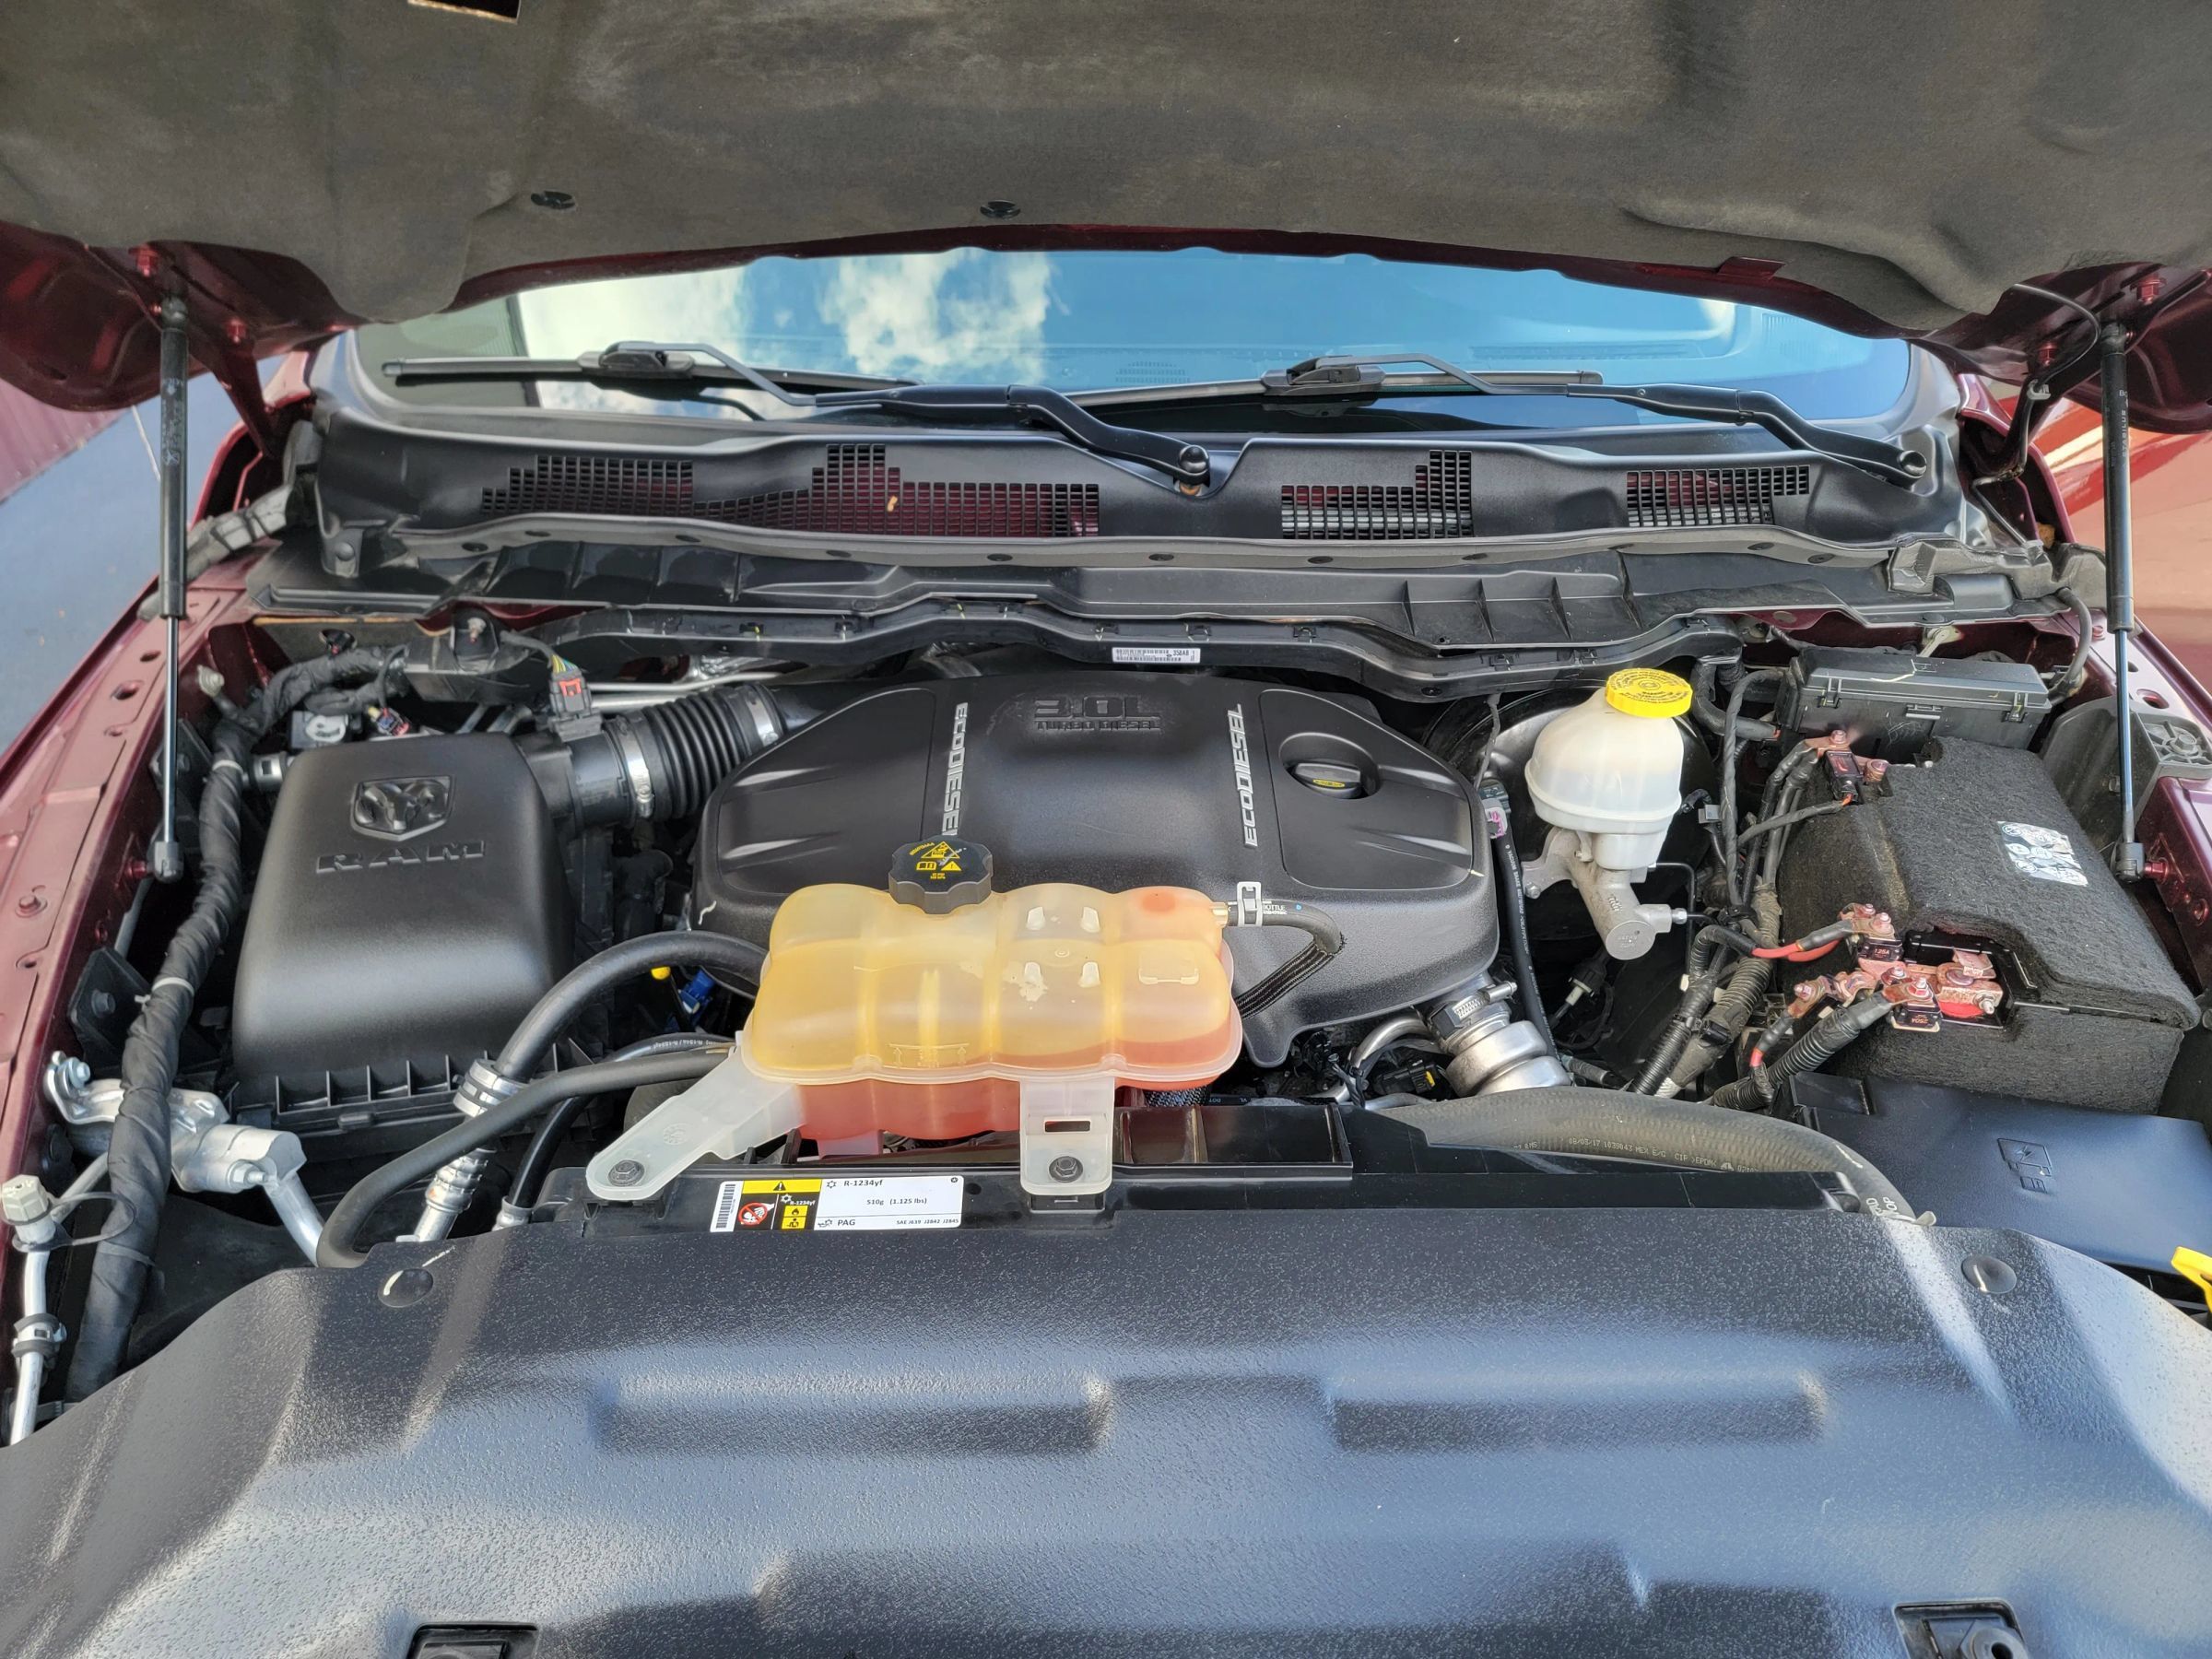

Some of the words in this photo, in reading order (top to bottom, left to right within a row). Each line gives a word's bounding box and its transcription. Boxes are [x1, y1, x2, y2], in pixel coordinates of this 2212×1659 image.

[1227, 702, 1258, 847] ECODIESEL
[315, 840, 484, 875] RAM
[843, 1179, 883, 1188] R-1234yf
[837, 1218, 856, 1227] PAG
